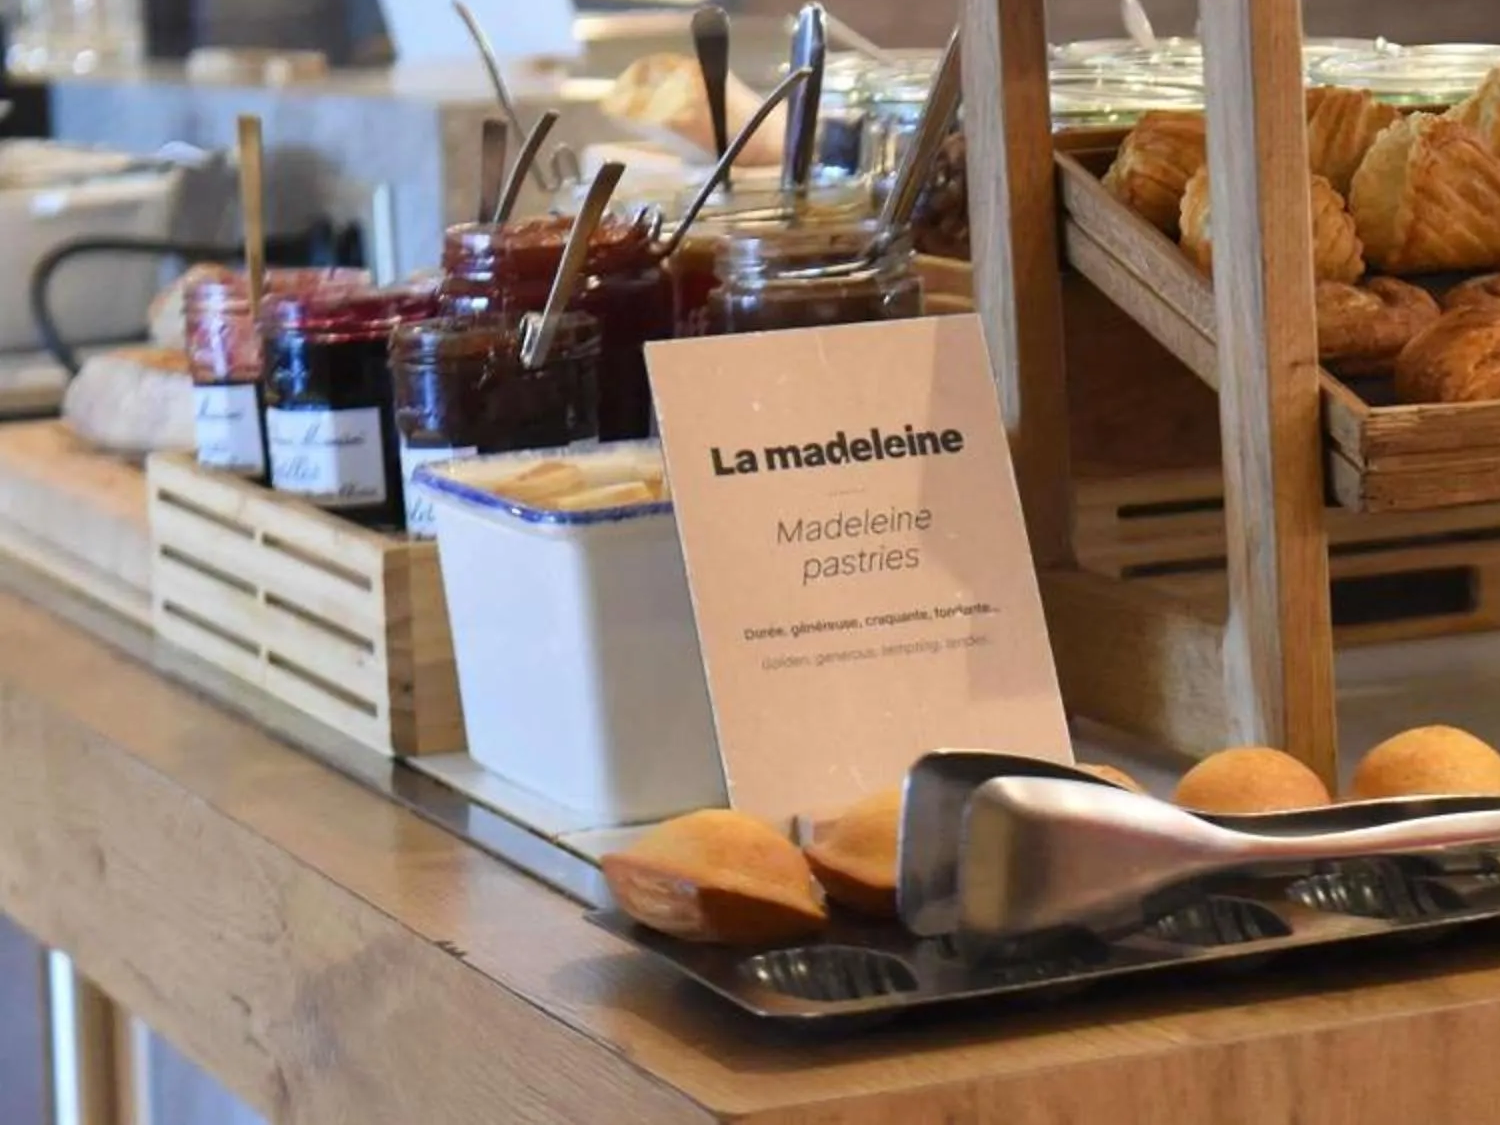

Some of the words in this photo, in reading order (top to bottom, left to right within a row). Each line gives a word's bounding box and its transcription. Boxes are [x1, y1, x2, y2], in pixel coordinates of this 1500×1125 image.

[711, 446, 759, 475] La
[764, 424, 964, 470] madeleine
[777, 506, 932, 544] Madeleine
[803, 545, 920, 586] pastries
